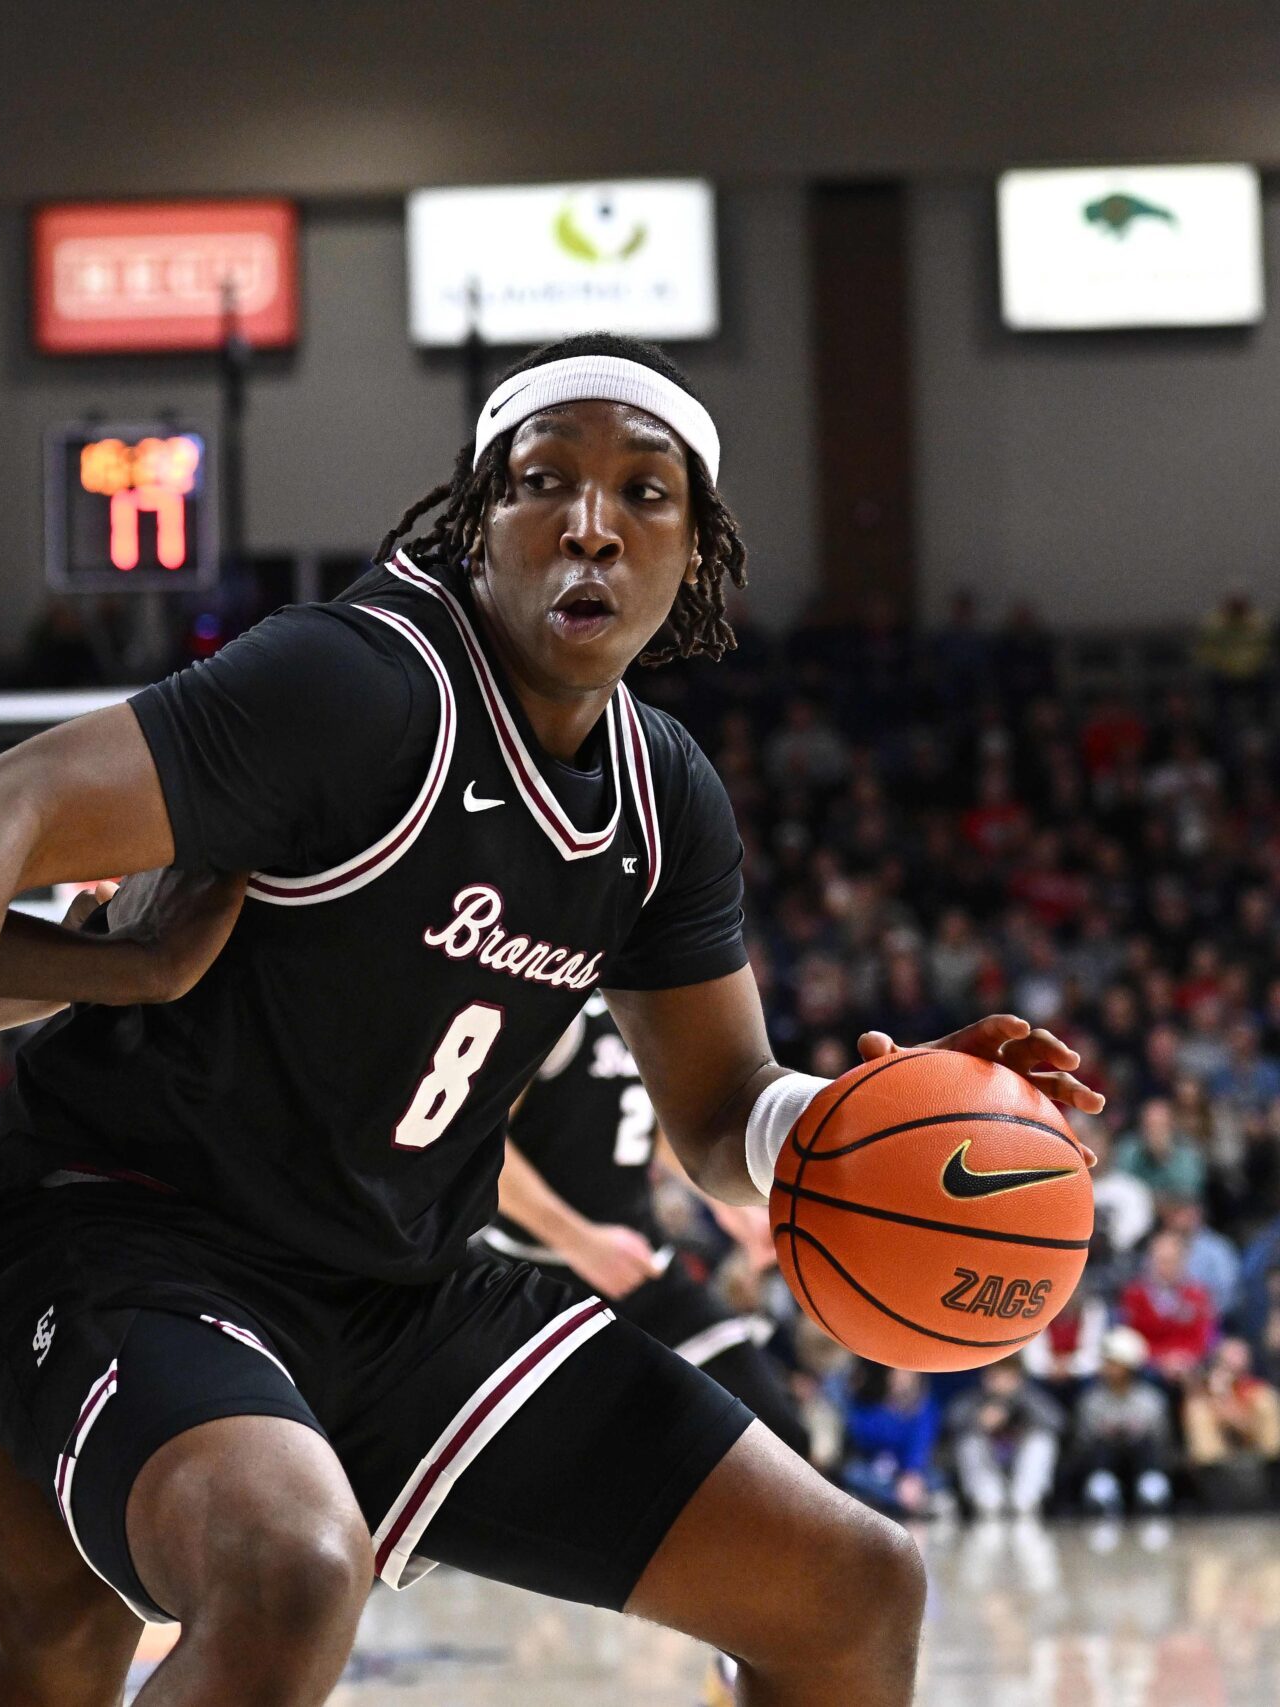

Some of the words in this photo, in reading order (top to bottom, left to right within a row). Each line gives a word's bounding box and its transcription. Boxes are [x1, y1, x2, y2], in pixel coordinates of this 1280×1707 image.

[422, 881, 605, 991] Broncos
[391, 999, 506, 1151] 8
[940, 1266, 1053, 1319] ZAGS
